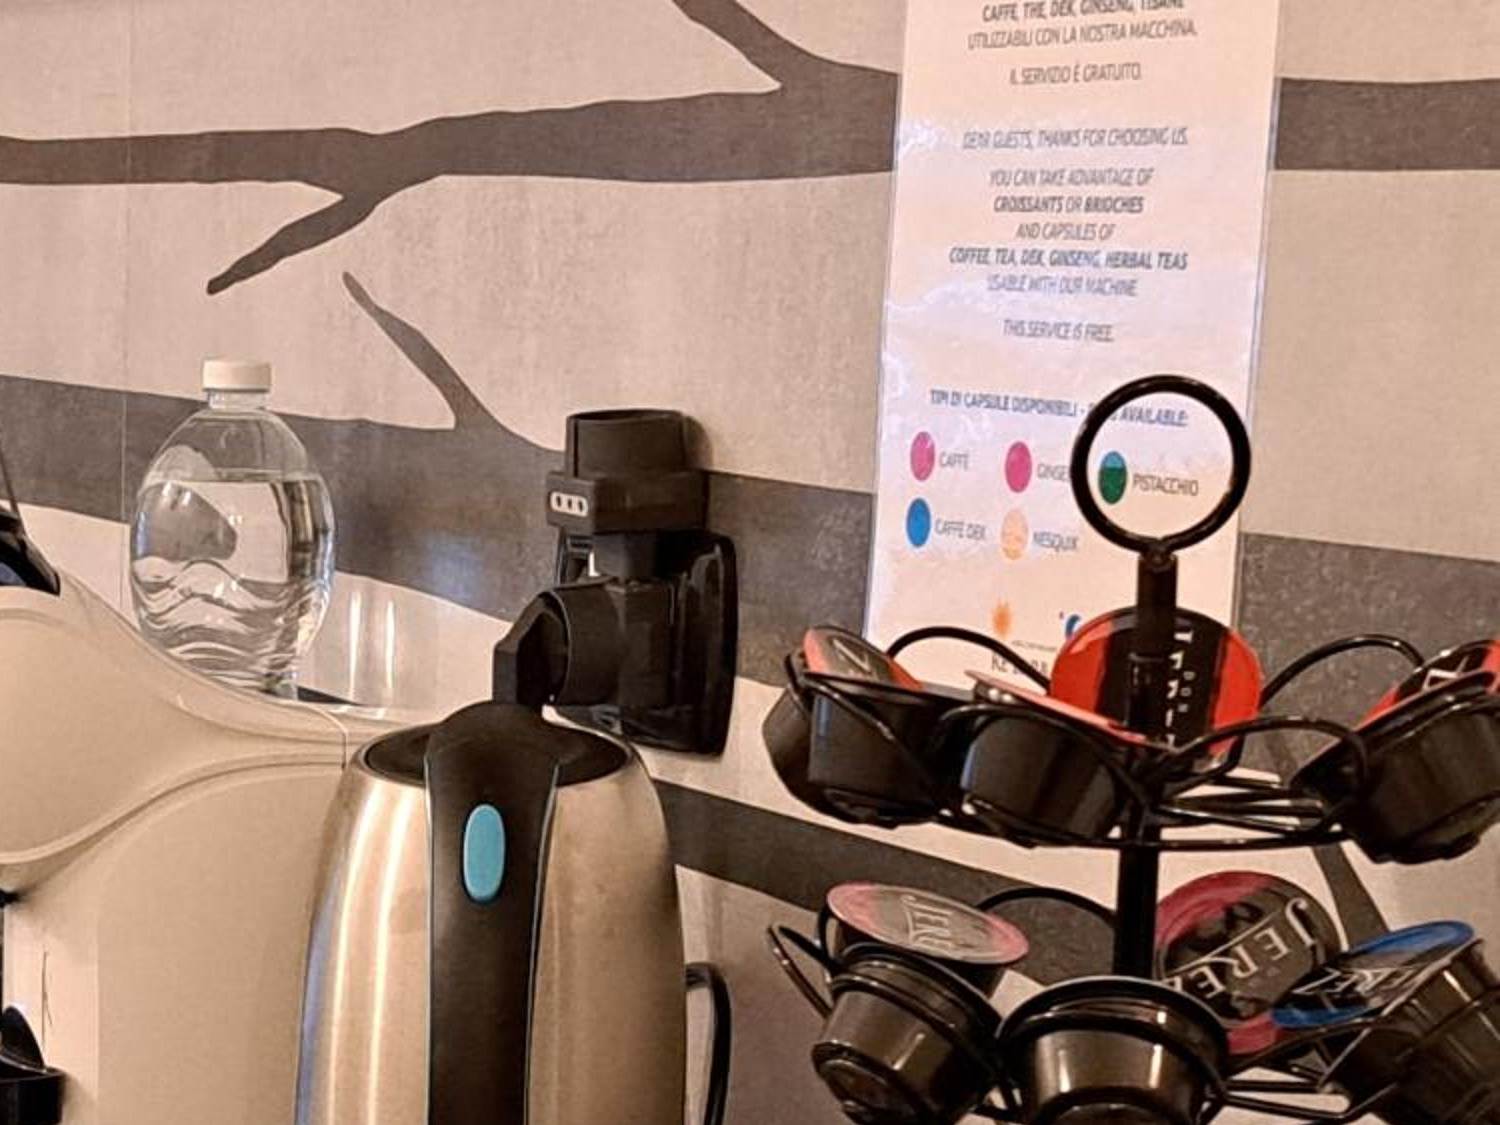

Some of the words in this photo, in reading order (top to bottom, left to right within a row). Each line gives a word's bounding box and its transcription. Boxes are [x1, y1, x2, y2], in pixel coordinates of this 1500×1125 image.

[1034, 27, 1060, 47] CON
[1061, 26, 1077, 45] LA
[1079, 22, 1126, 43] NOSTRA
[1020, 66, 1071, 85] SERVIZIO
[1037, 128, 1081, 148] THANKS
[1082, 128, 1106, 147] FOR
[1107, 126, 1169, 146] CHOOSING
[989, 167, 1013, 187] YOU
[1013, 167, 1037, 187] CAN
[1038, 167, 1067, 187] TAKE
[1067, 167, 1135, 187] ADVANTAGE
[1136, 167, 1155, 187] OF
[994, 196, 1064, 214] CROISSANTS
[1065, 196, 1084, 214] OR
[1084, 196, 1146, 214] BRIOCHES
[1015, 223, 1041, 240] AND
[1041, 223, 1097, 241] CAPSULES
[1098, 223, 1116, 241] OF
[1103, 250, 1155, 270] HERBAL
[1156, 251, 1190, 271] TEAS
[1058, 275, 1084, 295] OUR
[1003, 318, 1025, 338] THIS
[1025, 319, 1072, 340] SERVICE
[1073, 321, 1084, 341] IS
[963, 391, 1010, 411] CAPSULE
[1036, 463, 1071, 482] GINSE
[1132, 473, 1199, 497] PISTACCHIO
